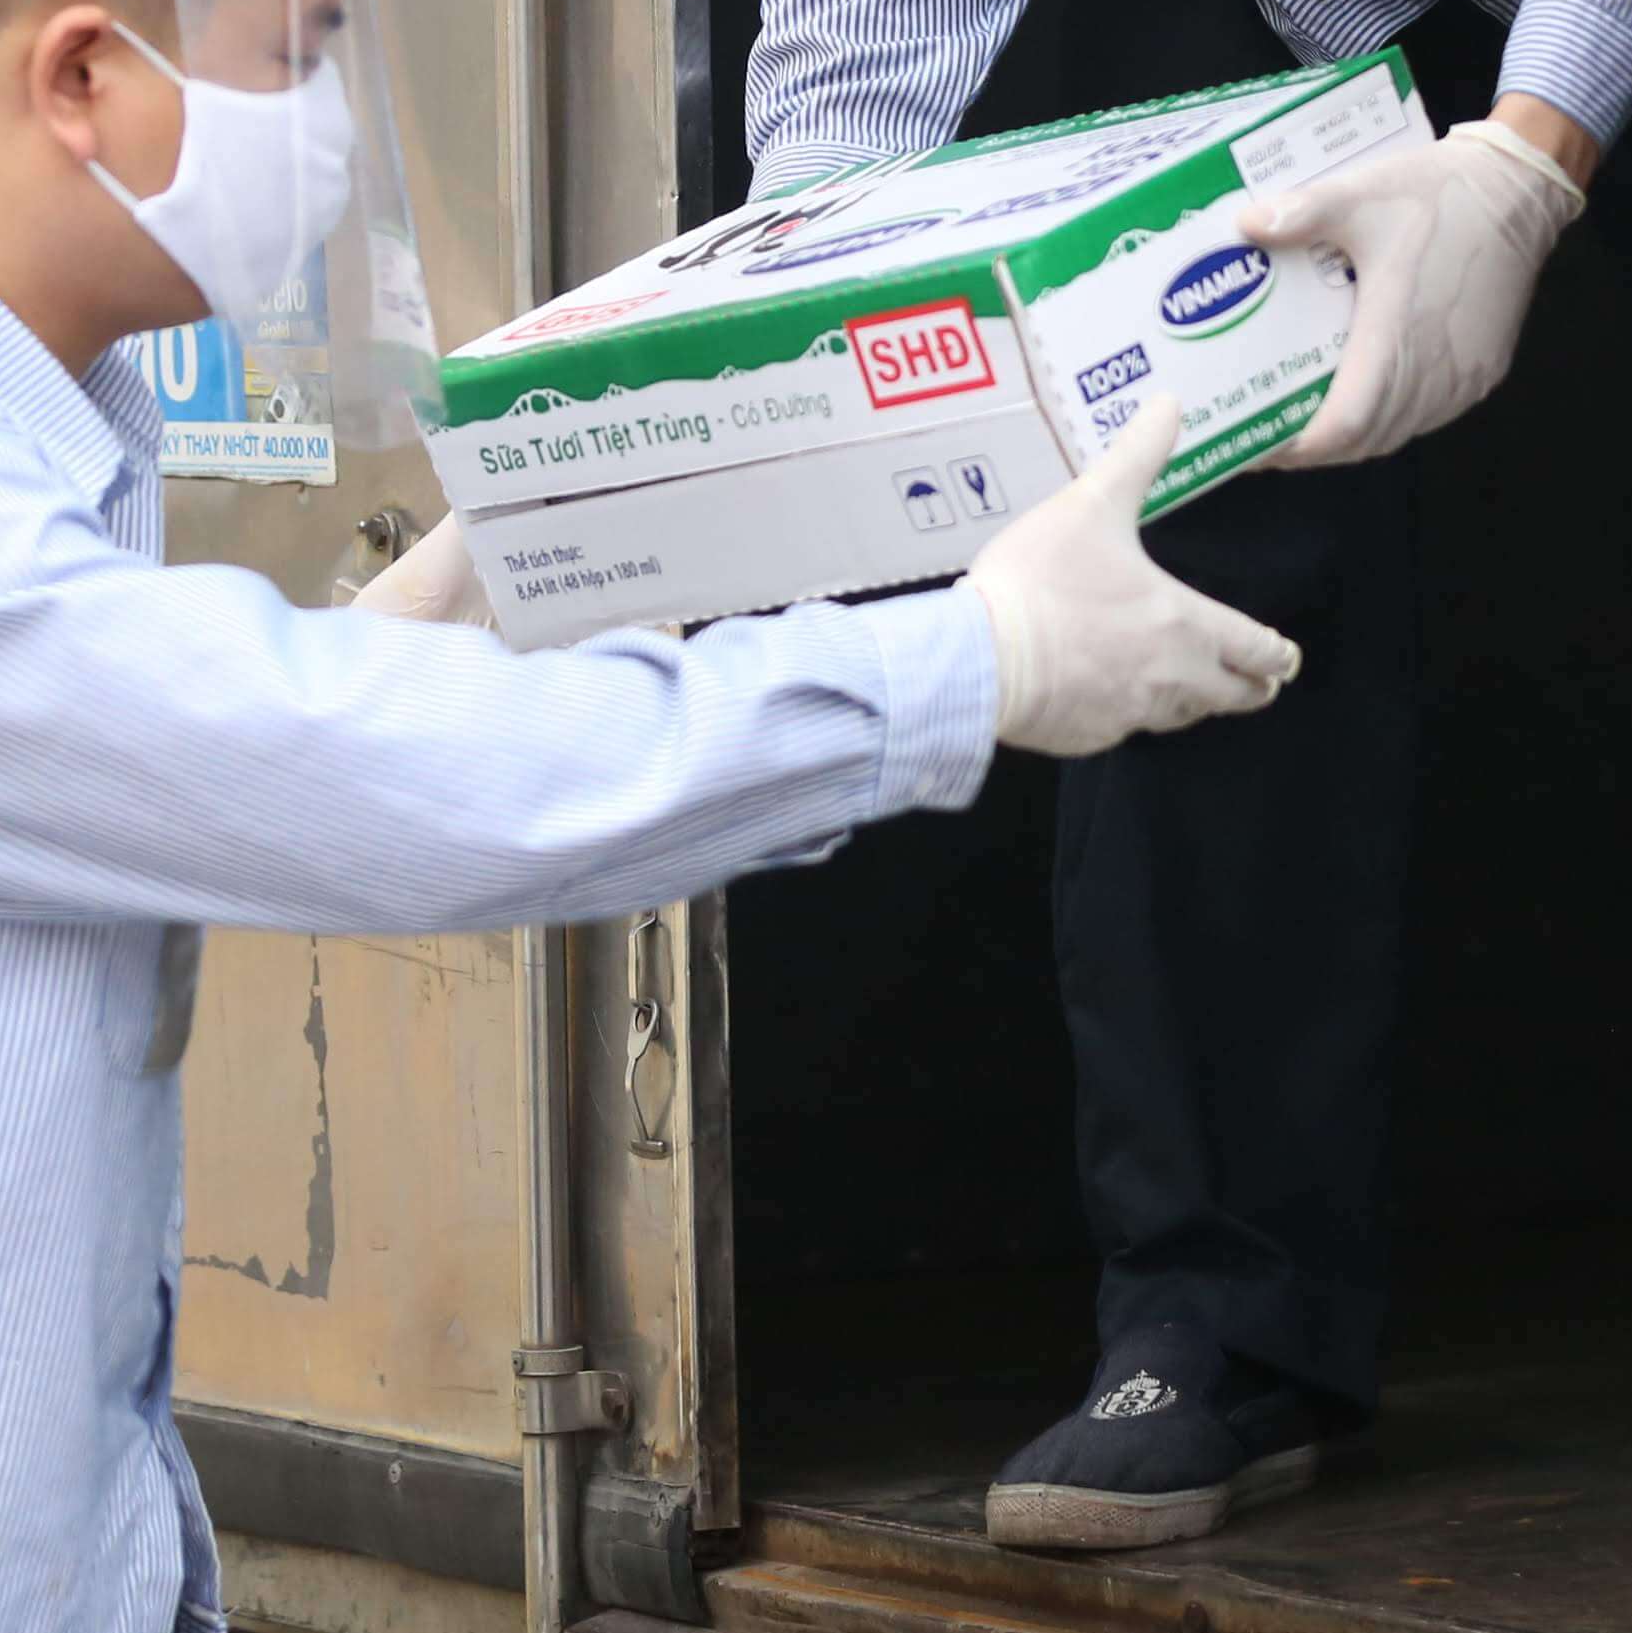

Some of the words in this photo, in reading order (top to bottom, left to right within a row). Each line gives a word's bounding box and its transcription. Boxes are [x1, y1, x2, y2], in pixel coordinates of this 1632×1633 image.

[1163, 249, 1267, 322] VINAMILK
[870, 325, 969, 383] SHĐ
[1079, 347, 1150, 400] 100%
[185, 434, 220, 456] THAY
[263, 435, 304, 458] 40.000
[307, 435, 329, 459] KM
[479, 444, 527, 475] Sữa
[528, 433, 584, 465] Tươi
[587, 424, 635, 457] Tiệt
[636, 412, 711, 448] Trùng
[730, 401, 760, 429] Có
[764, 390, 832, 422] Đường
[515, 578, 544, 602] 8,64
[614, 561, 639, 581] 180
